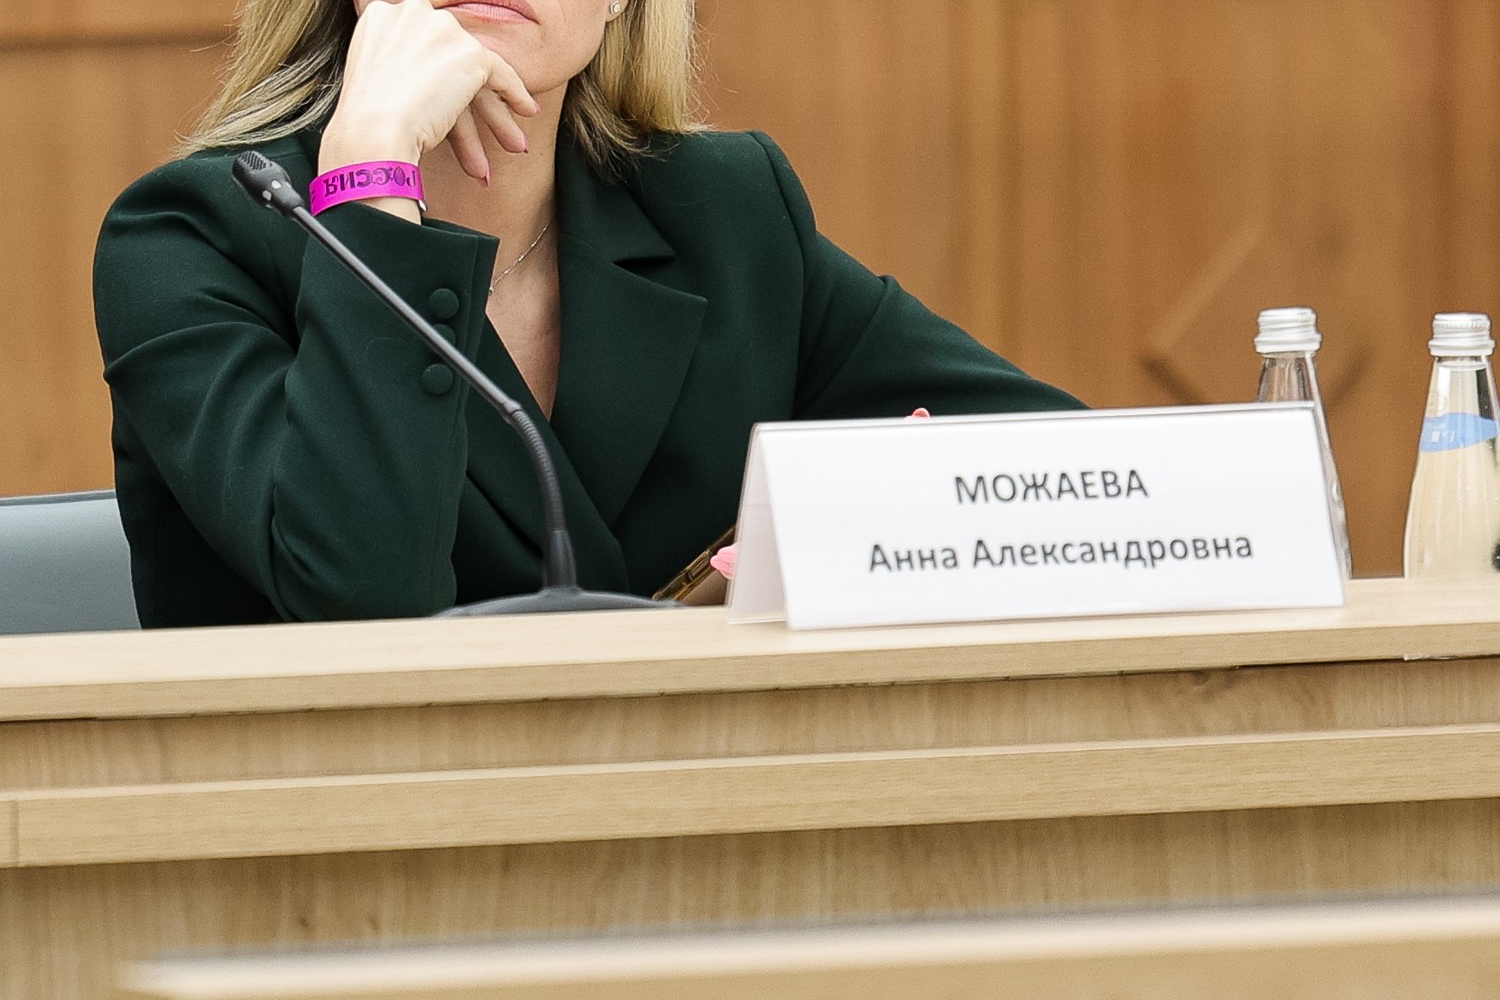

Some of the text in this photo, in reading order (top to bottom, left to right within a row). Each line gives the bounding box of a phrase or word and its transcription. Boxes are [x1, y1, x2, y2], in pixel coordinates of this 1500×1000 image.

[324, 166, 416, 197] РОССИЯ
[954, 468, 1148, 504] МОЖАЕВА
[869, 536, 1252, 572] Анна Александровна
